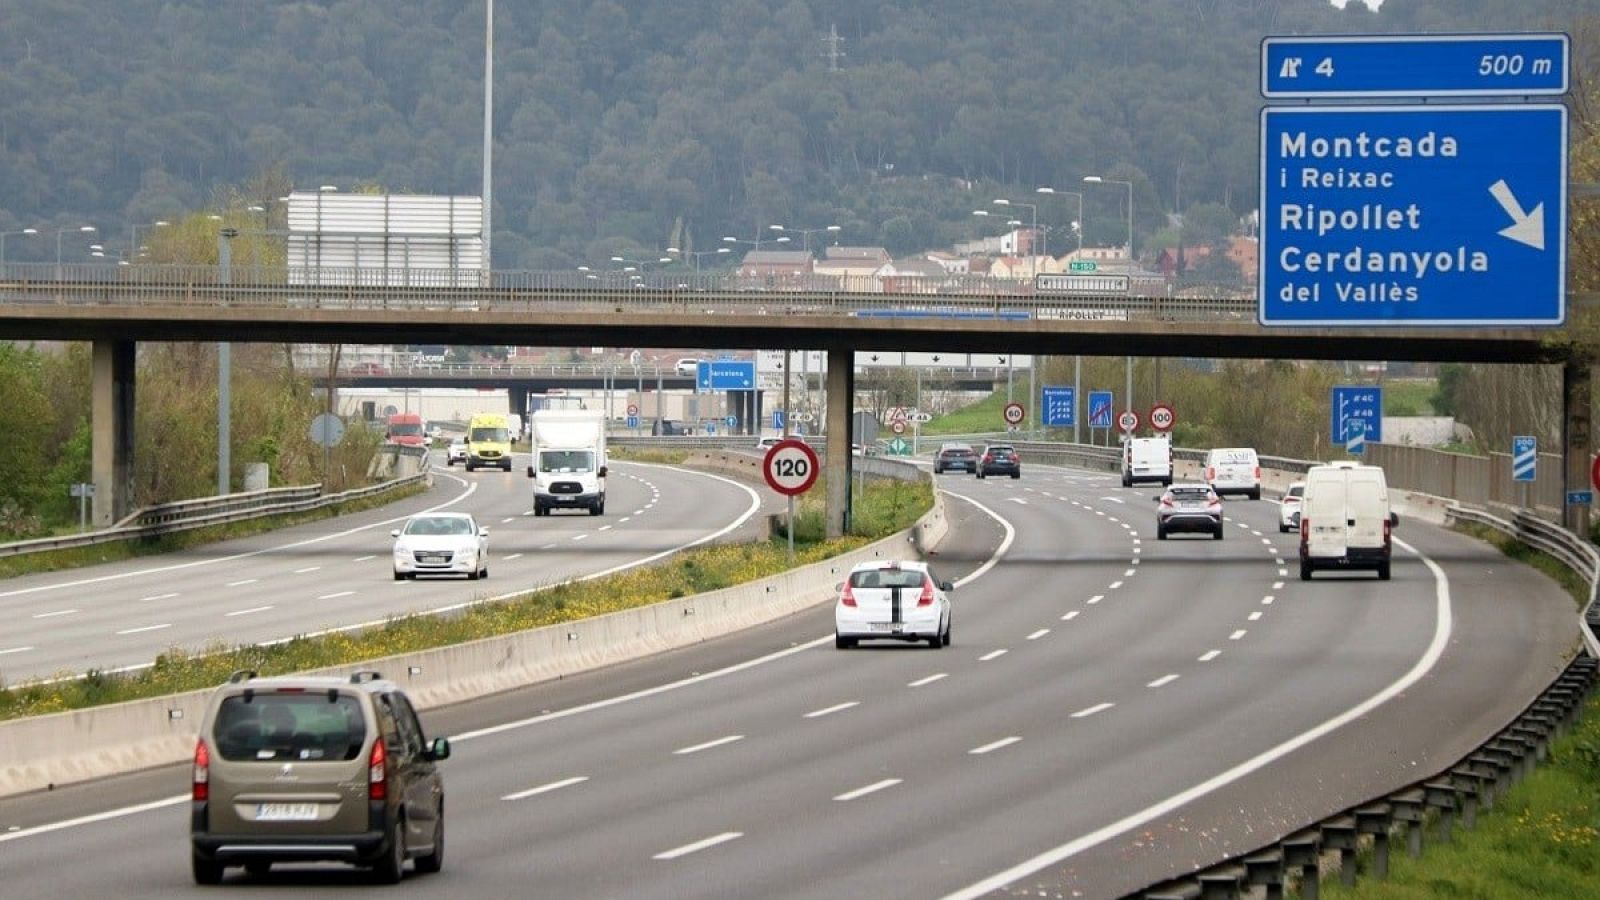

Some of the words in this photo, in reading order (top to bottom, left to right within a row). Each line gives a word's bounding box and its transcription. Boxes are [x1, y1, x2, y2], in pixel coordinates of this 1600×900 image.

[1316, 58, 1334, 77] 4
[1479, 55, 1523, 75] 500
[1532, 60, 1552, 74] m
[1280, 132, 1458, 157] Montcada
[1280, 168, 1286, 187] i
[1302, 168, 1393, 187] Reixac
[1280, 204, 1420, 236] Ripollet
[1280, 247, 1488, 278] Cerdanyola
[1280, 283, 1319, 301] del
[1336, 282, 1418, 301] Vallès
[1153, 413, 1170, 422] 100
[775, 459, 807, 476] 120
